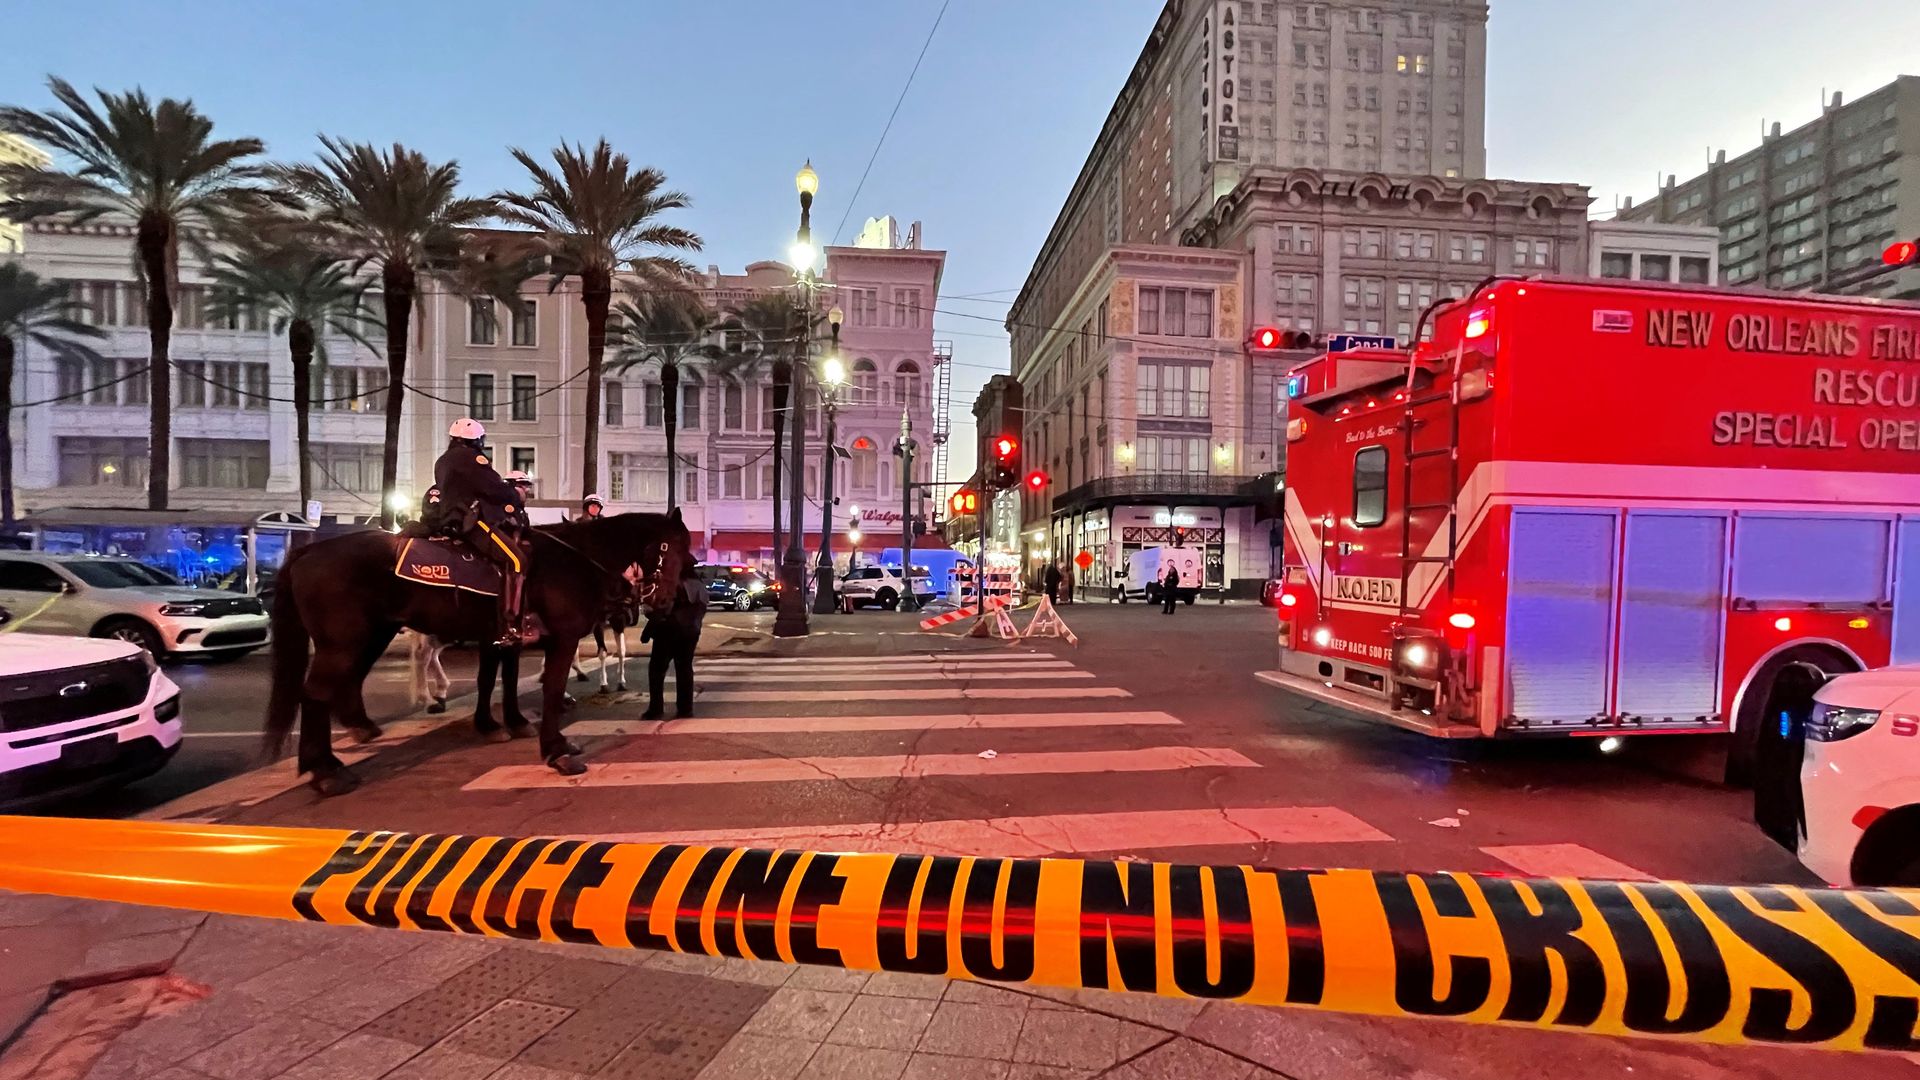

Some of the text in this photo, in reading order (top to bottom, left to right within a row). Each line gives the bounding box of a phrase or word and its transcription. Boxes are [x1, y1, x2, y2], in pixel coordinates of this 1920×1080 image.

[1222, 6, 1235, 123] ASTOR
[1345, 336, 1384, 350] Canal
[1648, 308, 1714, 347] NEW
[1727, 313, 1858, 358] ORLEANS
[1814, 368, 1920, 407] RESCU
[1713, 411, 1920, 451] SPECIAL OPE
[1337, 577, 1399, 604] N.O.F.D.
[1330, 638, 1393, 661] KEEP BACK 500 FE
[291, 830, 620, 945] POLICE
[625, 843, 850, 968] LINE
[1080, 859, 1331, 1006] NOT
[1371, 871, 1920, 1051] CROSS
